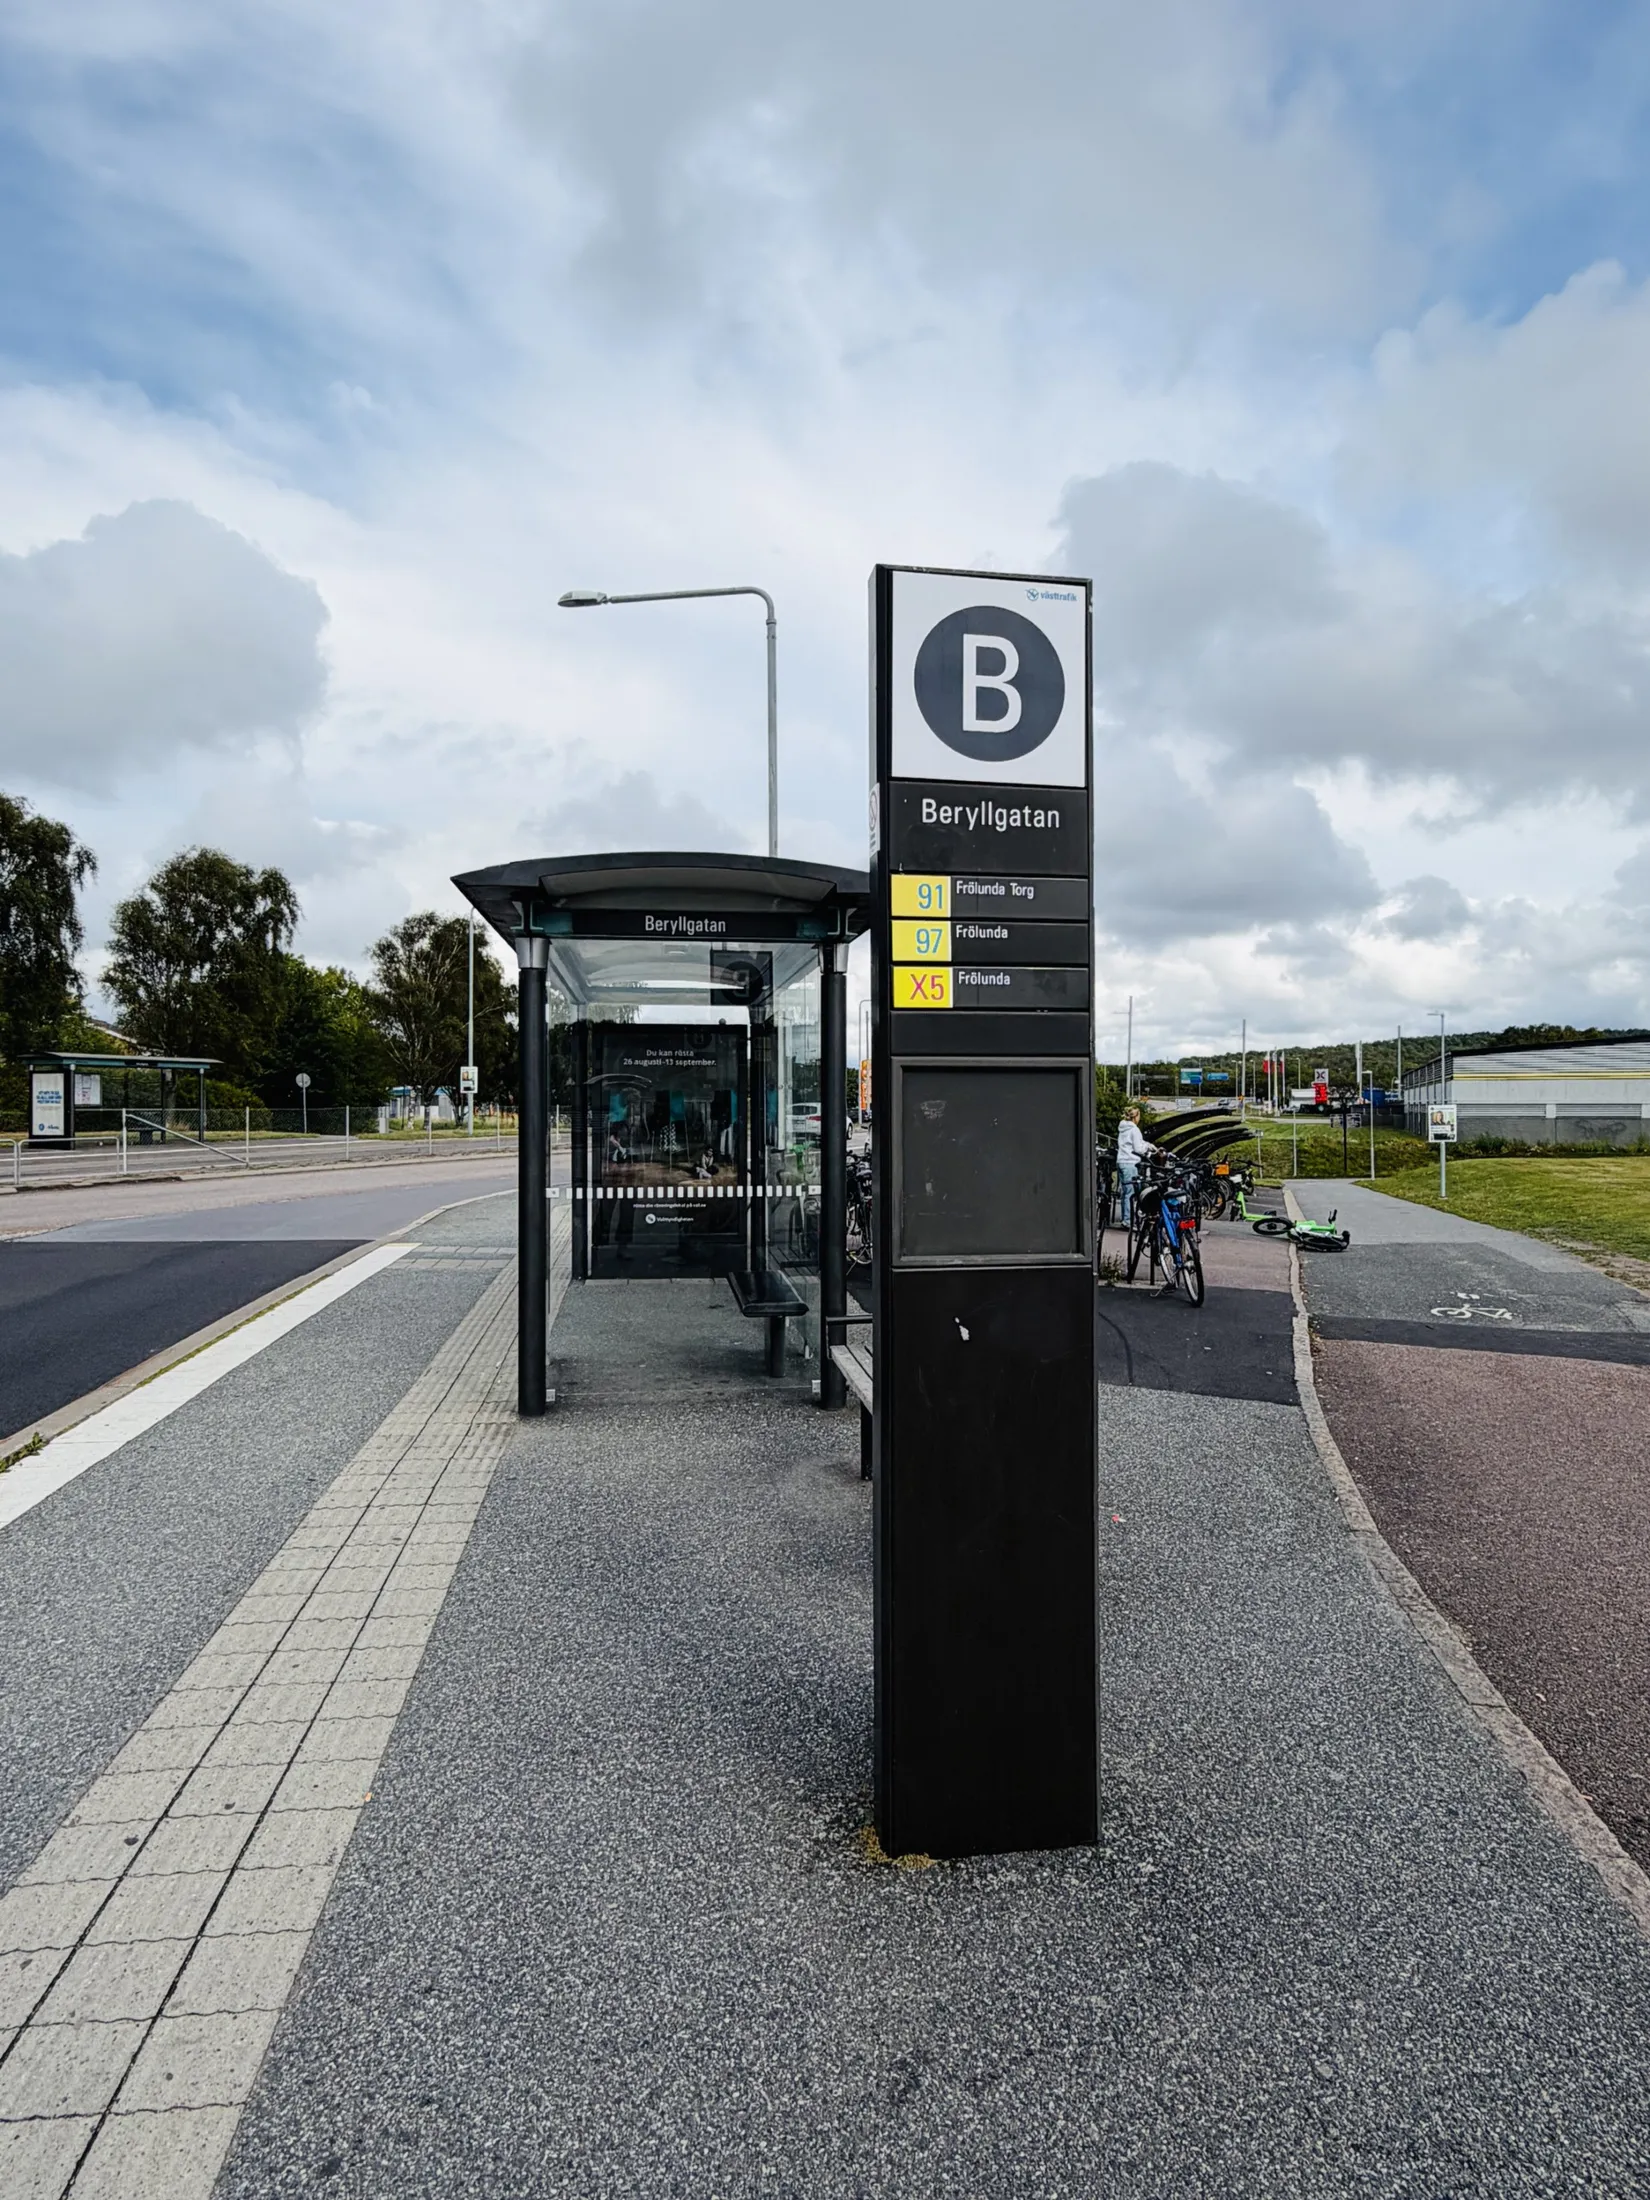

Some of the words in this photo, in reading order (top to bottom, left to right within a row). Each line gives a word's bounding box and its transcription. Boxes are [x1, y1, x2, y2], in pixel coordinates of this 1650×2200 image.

[1040, 591, 1077, 602] västtrafik
[962, 633, 1022, 734] B
[921, 798, 1060, 832] Beryllgatan
[917, 883, 944, 910] 91
[956, 880, 1005, 896] Frölunda
[1010, 882, 1035, 899] Torg
[645, 915, 726, 936] Beryllgatan
[916, 928, 943, 954] 97
[955, 924, 1008, 939] Frölunda
[910, 973, 944, 1001] X5
[957, 971, 1011, 986] Frölunda
